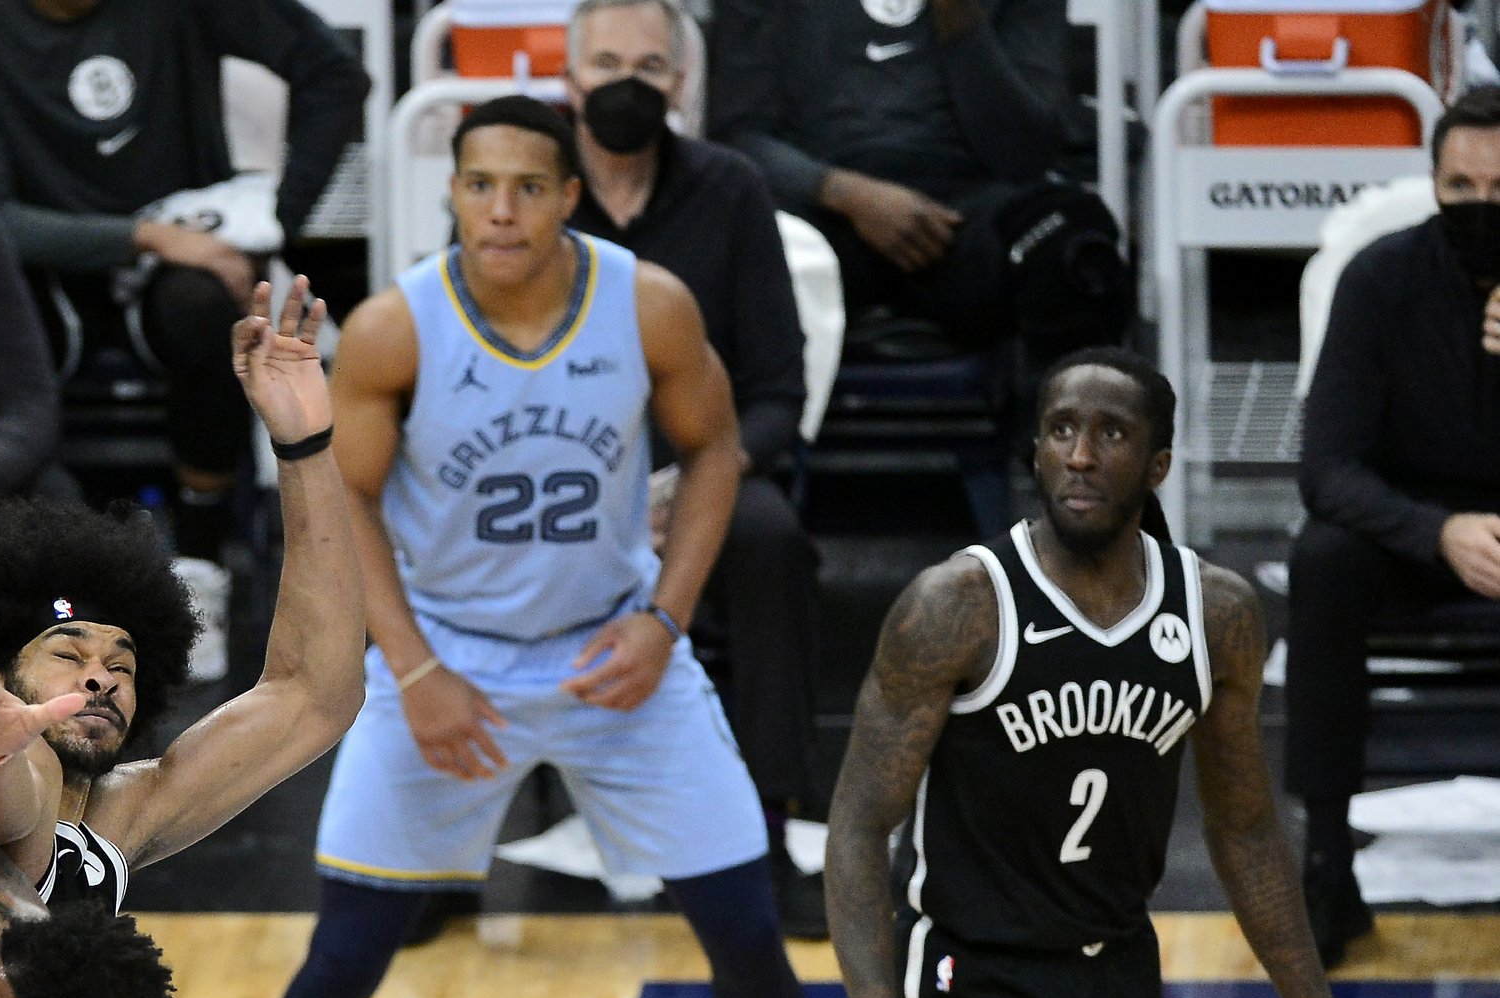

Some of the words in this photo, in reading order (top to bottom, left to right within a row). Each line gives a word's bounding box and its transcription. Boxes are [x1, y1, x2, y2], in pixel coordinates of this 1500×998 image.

[1208, 181, 1388, 209] GATORA
[476, 471, 599, 544] 22
[996, 679, 1197, 756] BROOKLYN
[1059, 768, 1108, 864] 2
